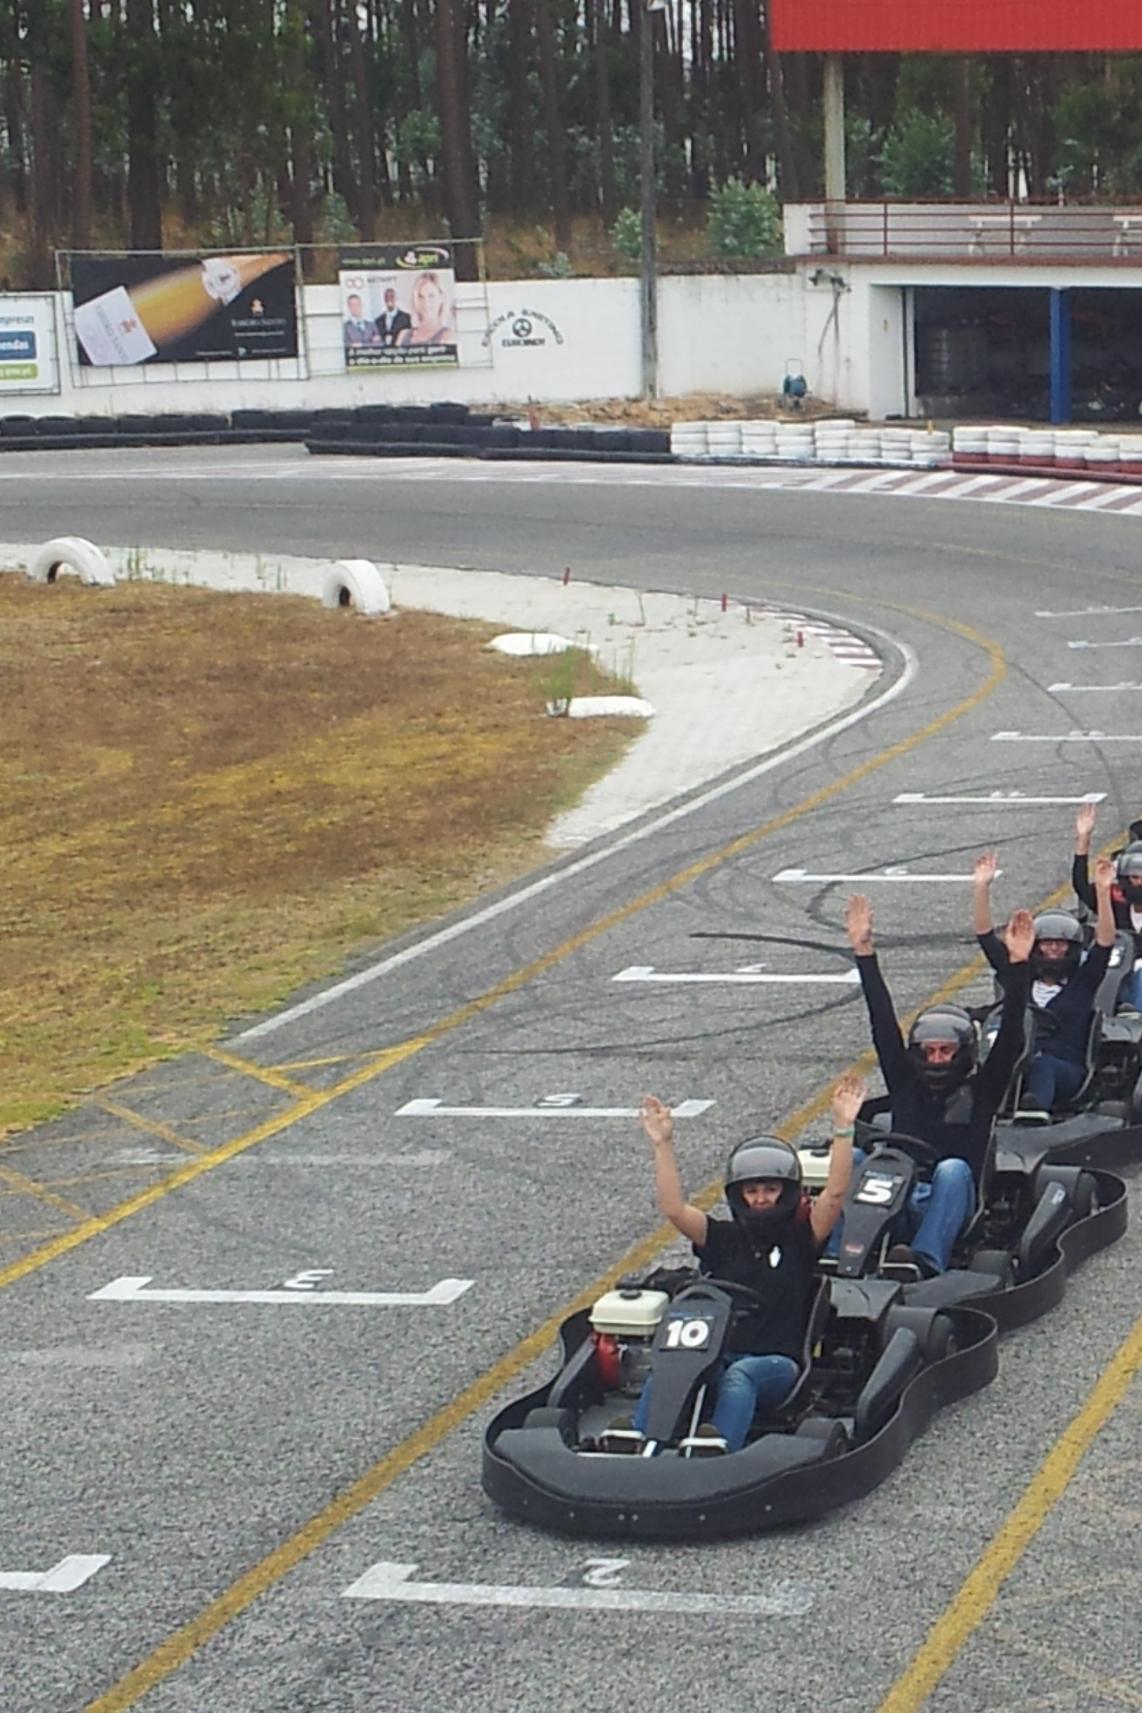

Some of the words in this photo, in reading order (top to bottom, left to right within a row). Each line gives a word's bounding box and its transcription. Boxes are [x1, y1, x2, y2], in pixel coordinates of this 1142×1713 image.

[856, 1178, 894, 1203] 5
[283, 1268, 335, 1289] 3
[666, 1319, 710, 1348] 10
[581, 1558, 631, 1586] 2
